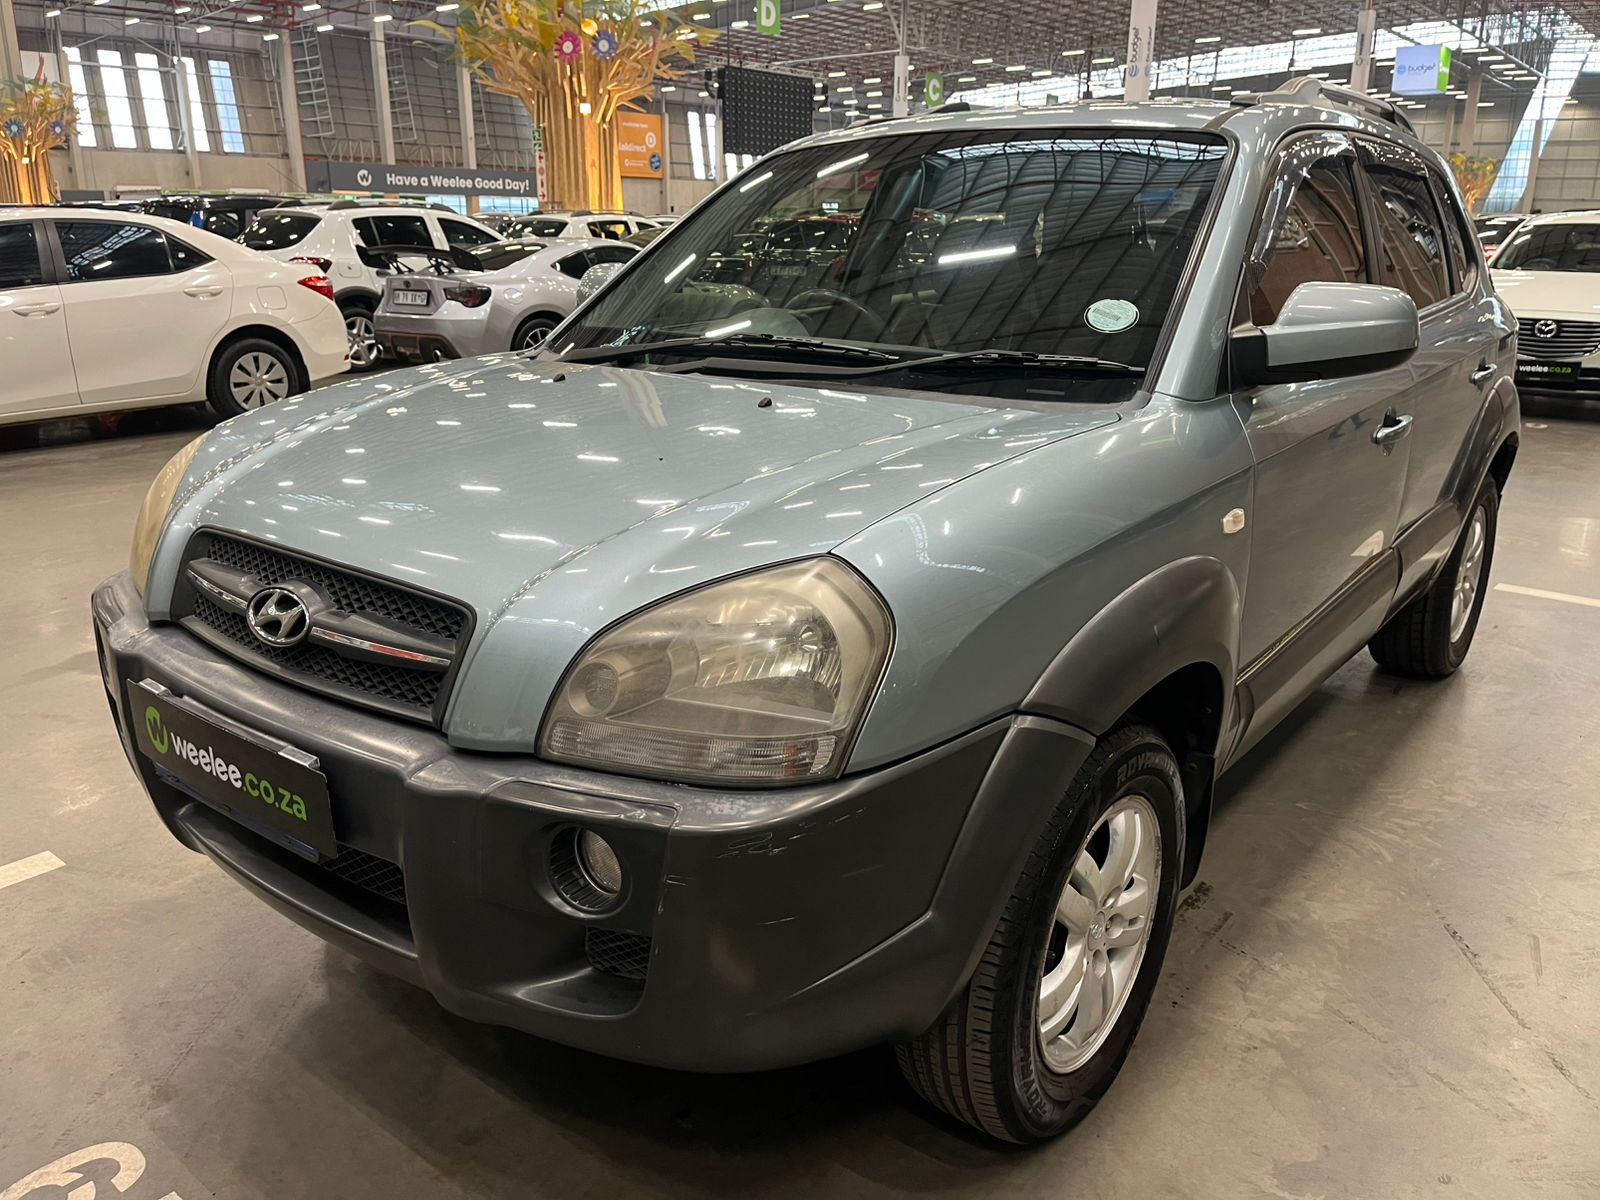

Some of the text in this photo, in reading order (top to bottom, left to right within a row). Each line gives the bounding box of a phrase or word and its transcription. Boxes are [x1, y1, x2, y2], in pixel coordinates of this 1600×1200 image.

[761, 0, 776, 27] D
[1130, 27, 1142, 63] budget
[1408, 63, 1436, 76] budget
[929, 78, 940, 101] C
[386, 173, 418, 186] Have
[420, 178, 429, 186] a
[430, 175, 473, 189] Weelee
[475, 178, 503, 189] Good
[505, 179, 529, 193] Day!
[170, 731, 308, 821] weelee.co.za
